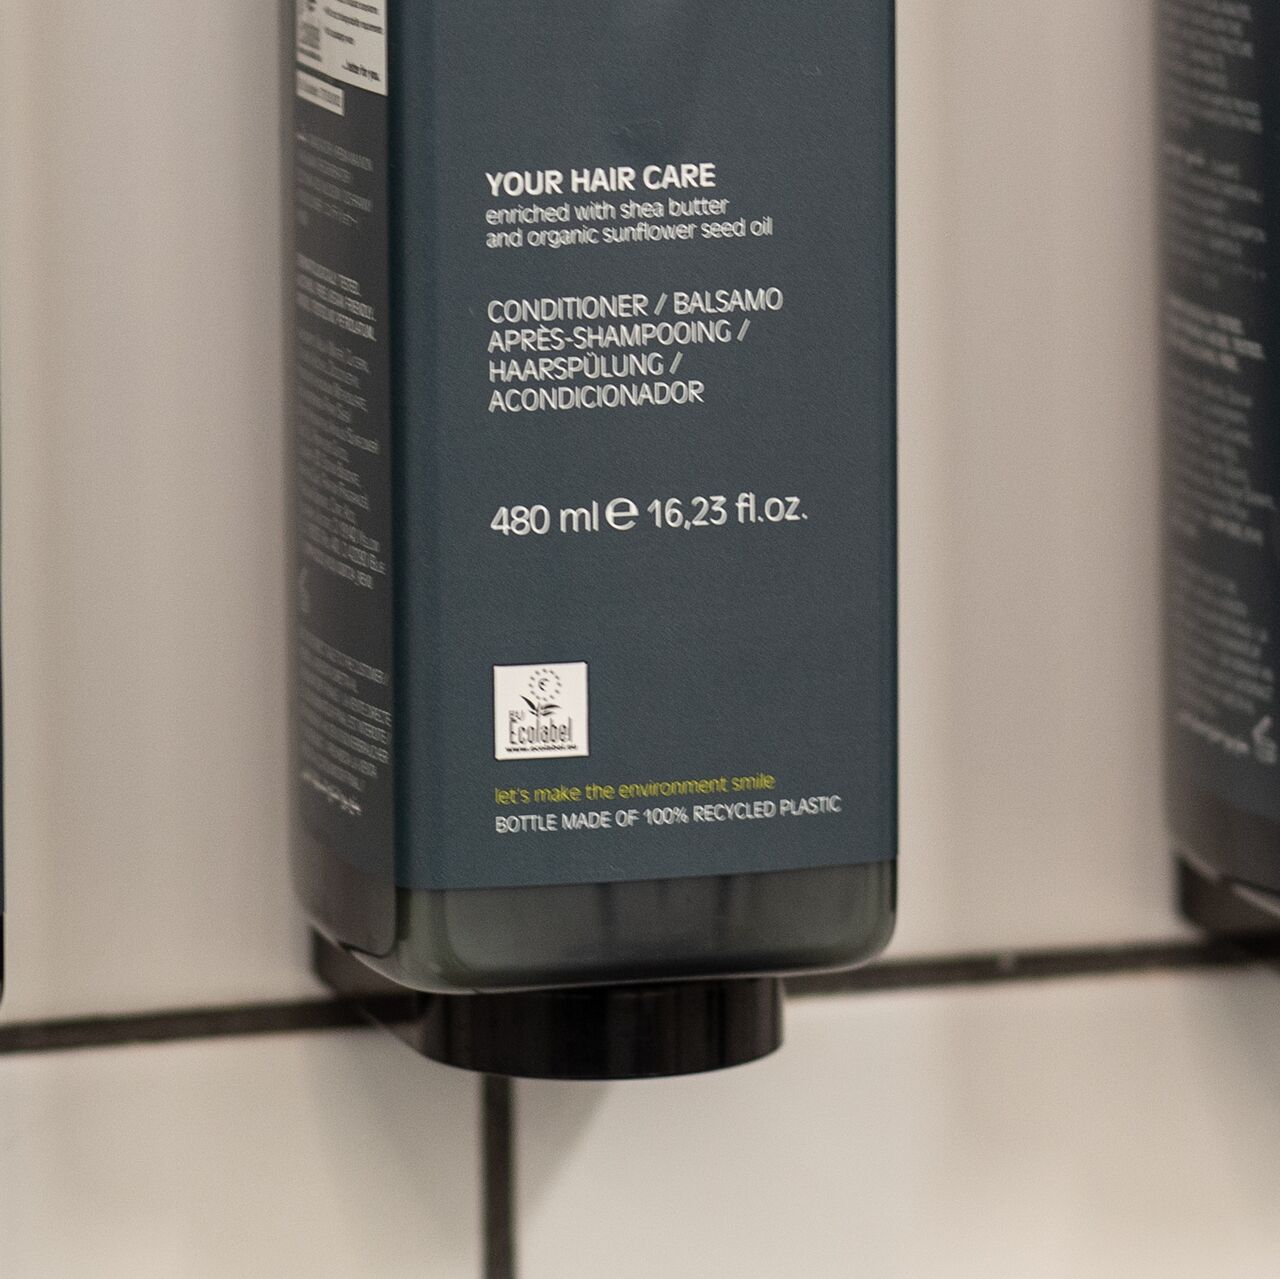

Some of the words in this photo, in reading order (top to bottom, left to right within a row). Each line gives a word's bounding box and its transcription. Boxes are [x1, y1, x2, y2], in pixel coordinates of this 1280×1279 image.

[485, 171, 563, 198] YOUR
[571, 167, 636, 192] HAIR
[642, 162, 716, 189] CARE
[485, 204, 570, 225] enriched
[574, 201, 615, 221] with
[620, 199, 664, 219] shea
[668, 196, 729, 216] butter
[485, 227, 522, 249] and
[527, 224, 599, 248] organic
[602, 221, 697, 244] sunflower
[701, 219, 746, 239] seed
[750, 216, 773, 237] oil
[487, 294, 648, 324] CONDITIONER
[674, 287, 783, 315] BALSAMO
[488, 319, 732, 353] APRÈS-SHAMPOOING
[489, 351, 664, 383] HAARSPÜLUNG
[488, 380, 705, 414] ACONDICIONADOR
[490, 504, 550, 537] 480
[735, 492, 807, 523] fl.oz.
[509, 717, 573, 744] Ecolabel
[495, 786, 530, 805] let's
[534, 784, 581, 803] make
[585, 781, 615, 801] the
[618, 774, 728, 799] environment
[731, 773, 775, 793] smile
[495, 814, 557, 834] BOTTLE
[562, 811, 611, 831] MADE
[615, 810, 639, 828] OF
[643, 806, 689, 827] 100%
[693, 801, 776, 823] RECYCLED
[779, 795, 842, 817] PLASTIC
